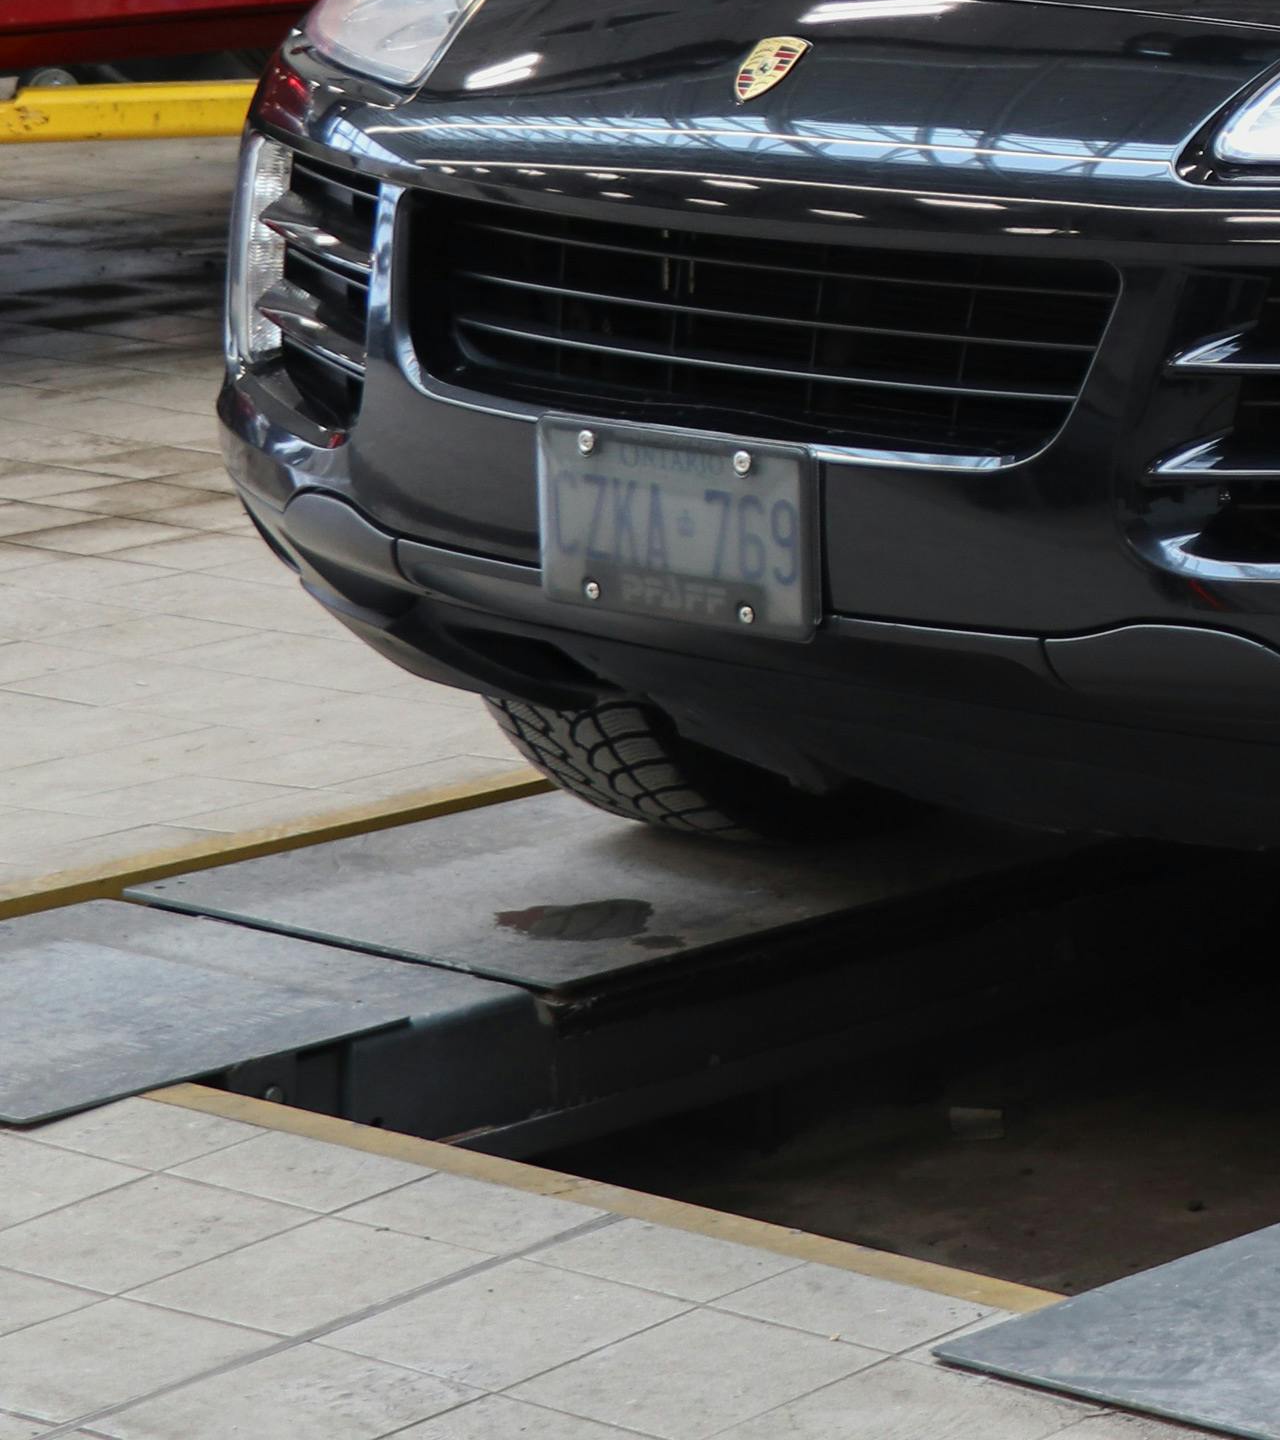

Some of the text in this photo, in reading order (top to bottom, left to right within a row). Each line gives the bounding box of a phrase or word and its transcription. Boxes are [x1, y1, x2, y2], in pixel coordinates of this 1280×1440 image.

[553, 469, 799, 586] CZKA 769
[622, 574, 727, 615] PFAFF
